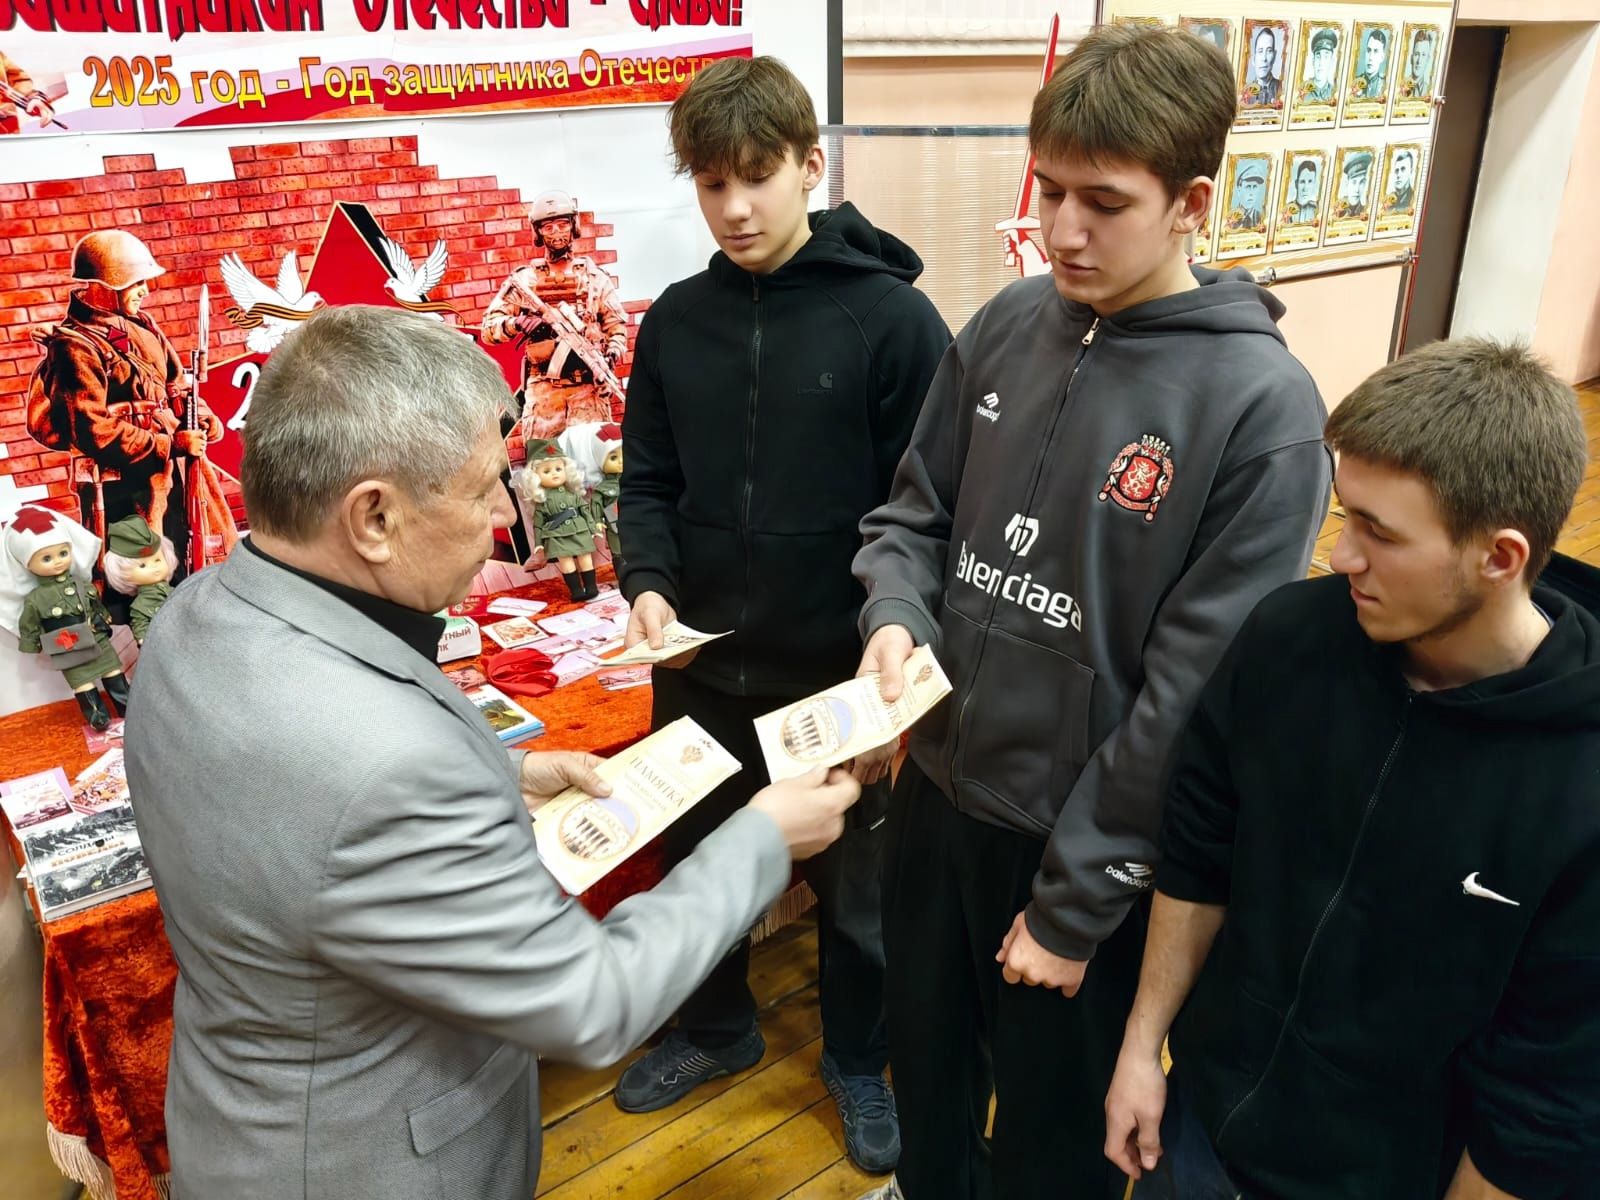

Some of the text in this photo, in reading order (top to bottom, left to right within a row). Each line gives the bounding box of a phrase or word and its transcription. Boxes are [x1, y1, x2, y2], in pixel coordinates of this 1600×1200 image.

[83, 48, 716, 109] 2025 год - Год защитника Отечест
[444, 626, 472, 641] ТНЫЙ
